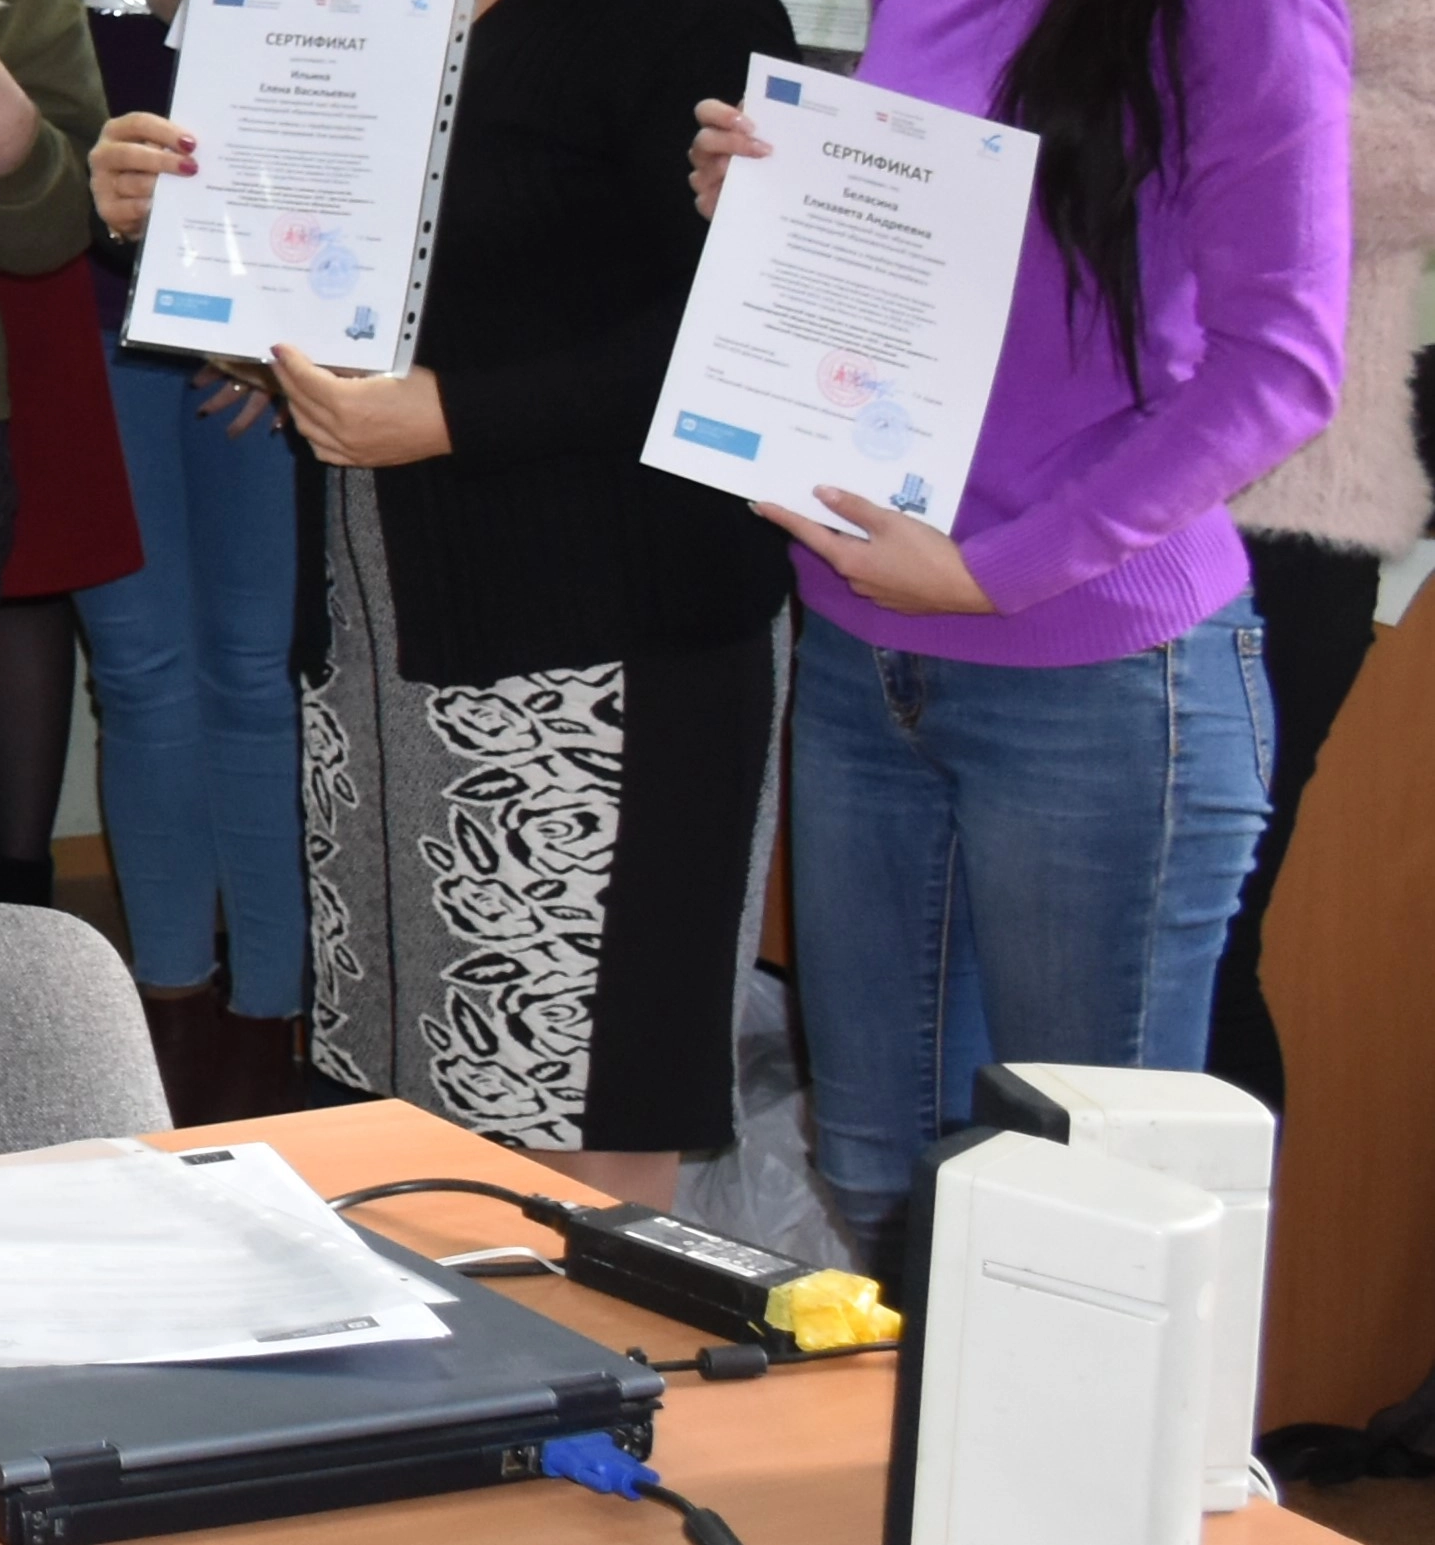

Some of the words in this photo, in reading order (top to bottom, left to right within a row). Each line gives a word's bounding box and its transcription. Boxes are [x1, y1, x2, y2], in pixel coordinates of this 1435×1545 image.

[265, 32, 366, 51] СЕРТИФИКАТ
[259, 84, 292, 95] Елена
[822, 141, 933, 183] СЕРТИФИКАТ
[803, 195, 864, 221] Елизавета
[864, 213, 933, 240] Андреевна
